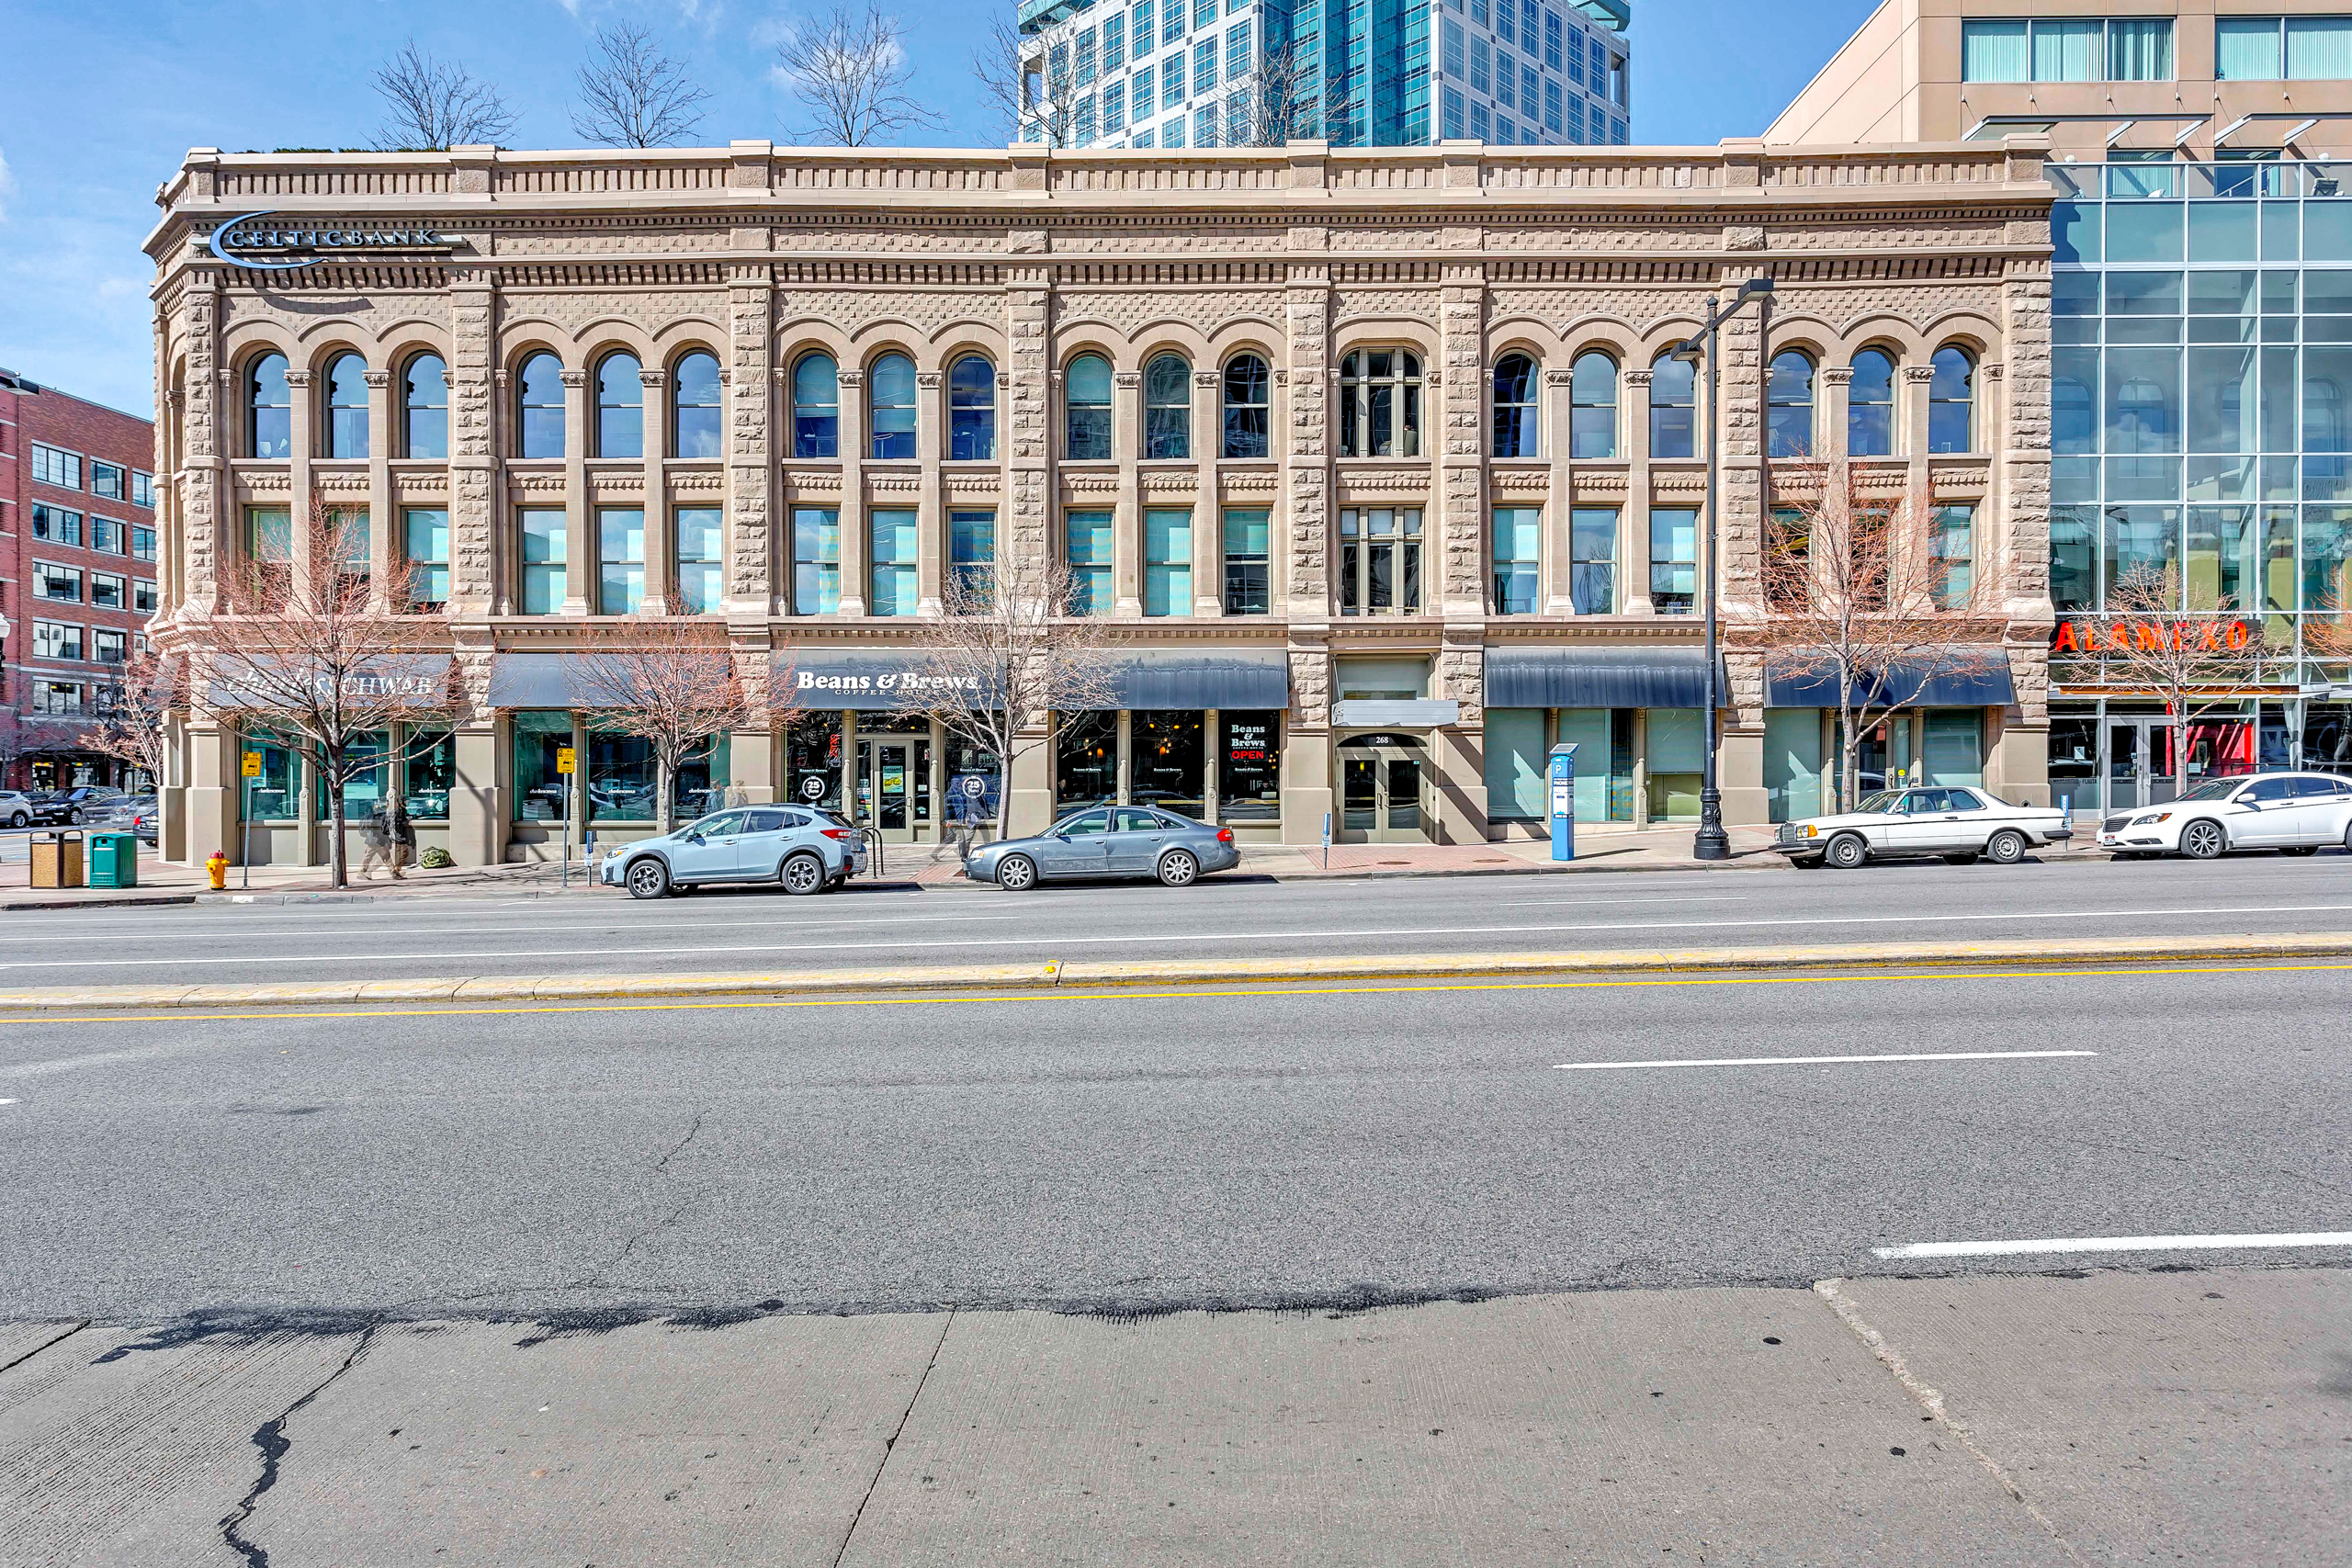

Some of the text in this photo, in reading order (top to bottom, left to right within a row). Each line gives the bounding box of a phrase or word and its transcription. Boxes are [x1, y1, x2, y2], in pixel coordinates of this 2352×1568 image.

[2055, 621, 2247, 651] ALAMEXO
[797, 671, 978, 689] Beans & Brews
[1231, 724, 1265, 733] Beans
[1243, 732, 1253, 740] &
[1375, 736, 1389, 744] 268
[1231, 738, 1265, 747] Brews
[1231, 750, 1264, 760] OPEN
[1555, 764, 1562, 774] P
[808, 781, 820, 789] 25
